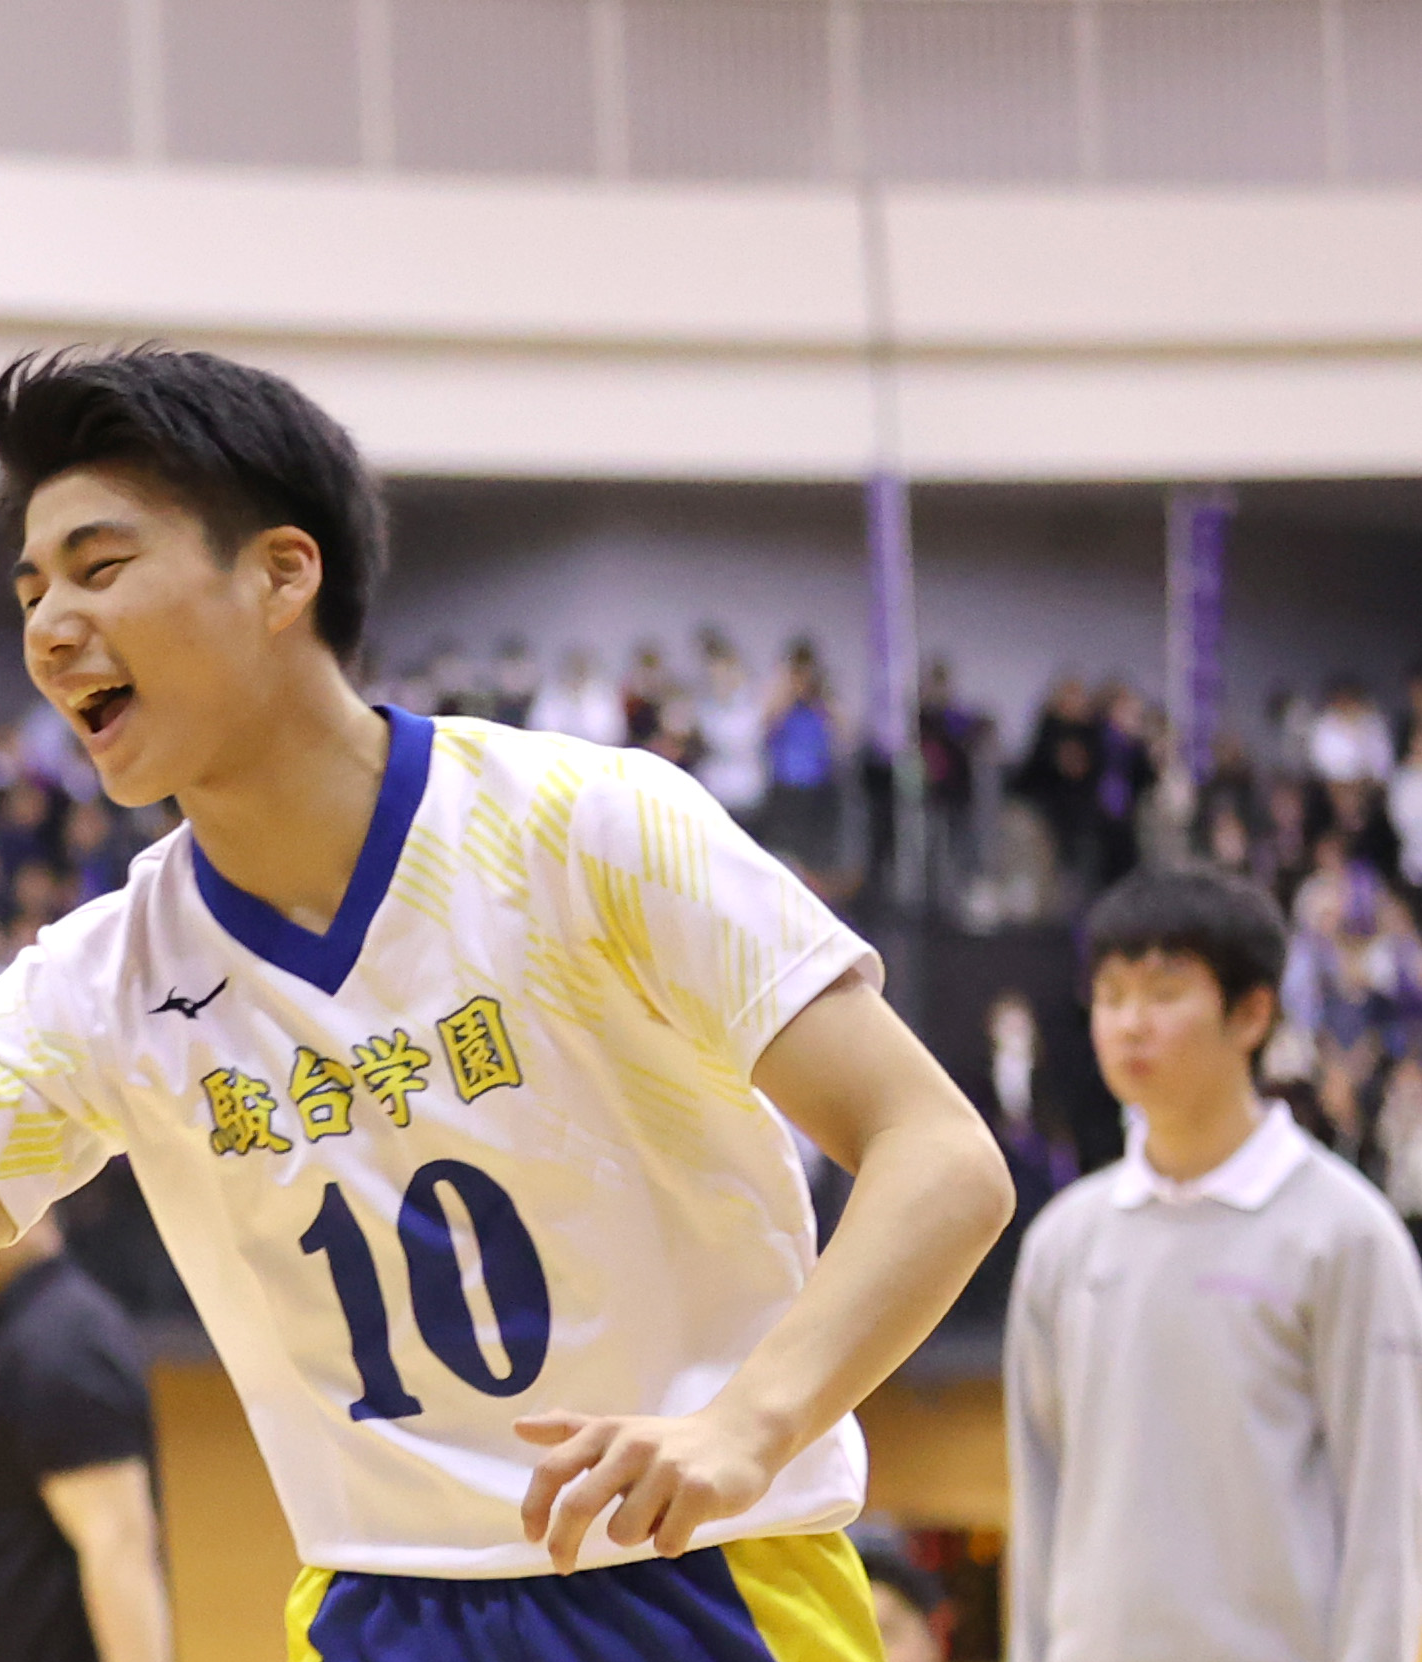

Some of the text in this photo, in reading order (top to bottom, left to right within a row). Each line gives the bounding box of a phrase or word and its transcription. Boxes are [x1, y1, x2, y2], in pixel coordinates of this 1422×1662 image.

[200, 995, 525, 1157] 駿台学園
[299, 1158, 551, 1422] 10
